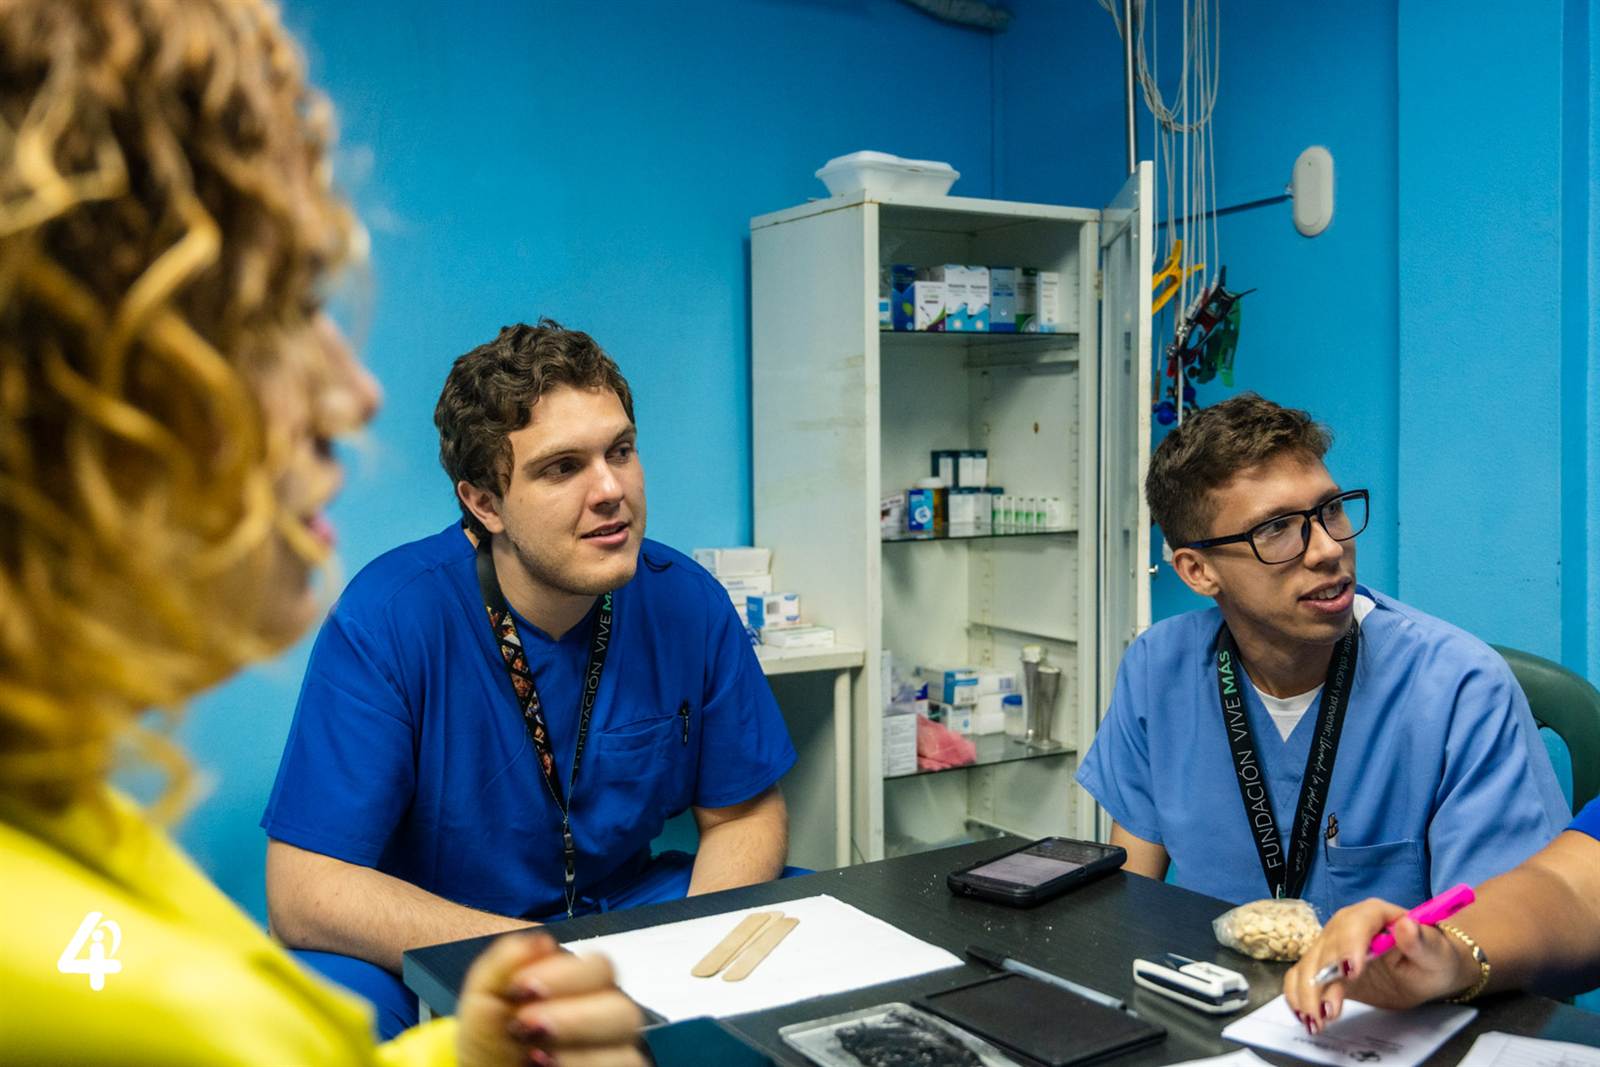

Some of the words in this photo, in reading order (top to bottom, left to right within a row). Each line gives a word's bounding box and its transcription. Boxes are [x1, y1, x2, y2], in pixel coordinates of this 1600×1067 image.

[595, 614, 611, 653] VIVE
[1218, 651, 1237, 695] MÁS
[1225, 697, 1248, 742] VIVE
[1237, 750, 1282, 869] FUNDACIÓN
